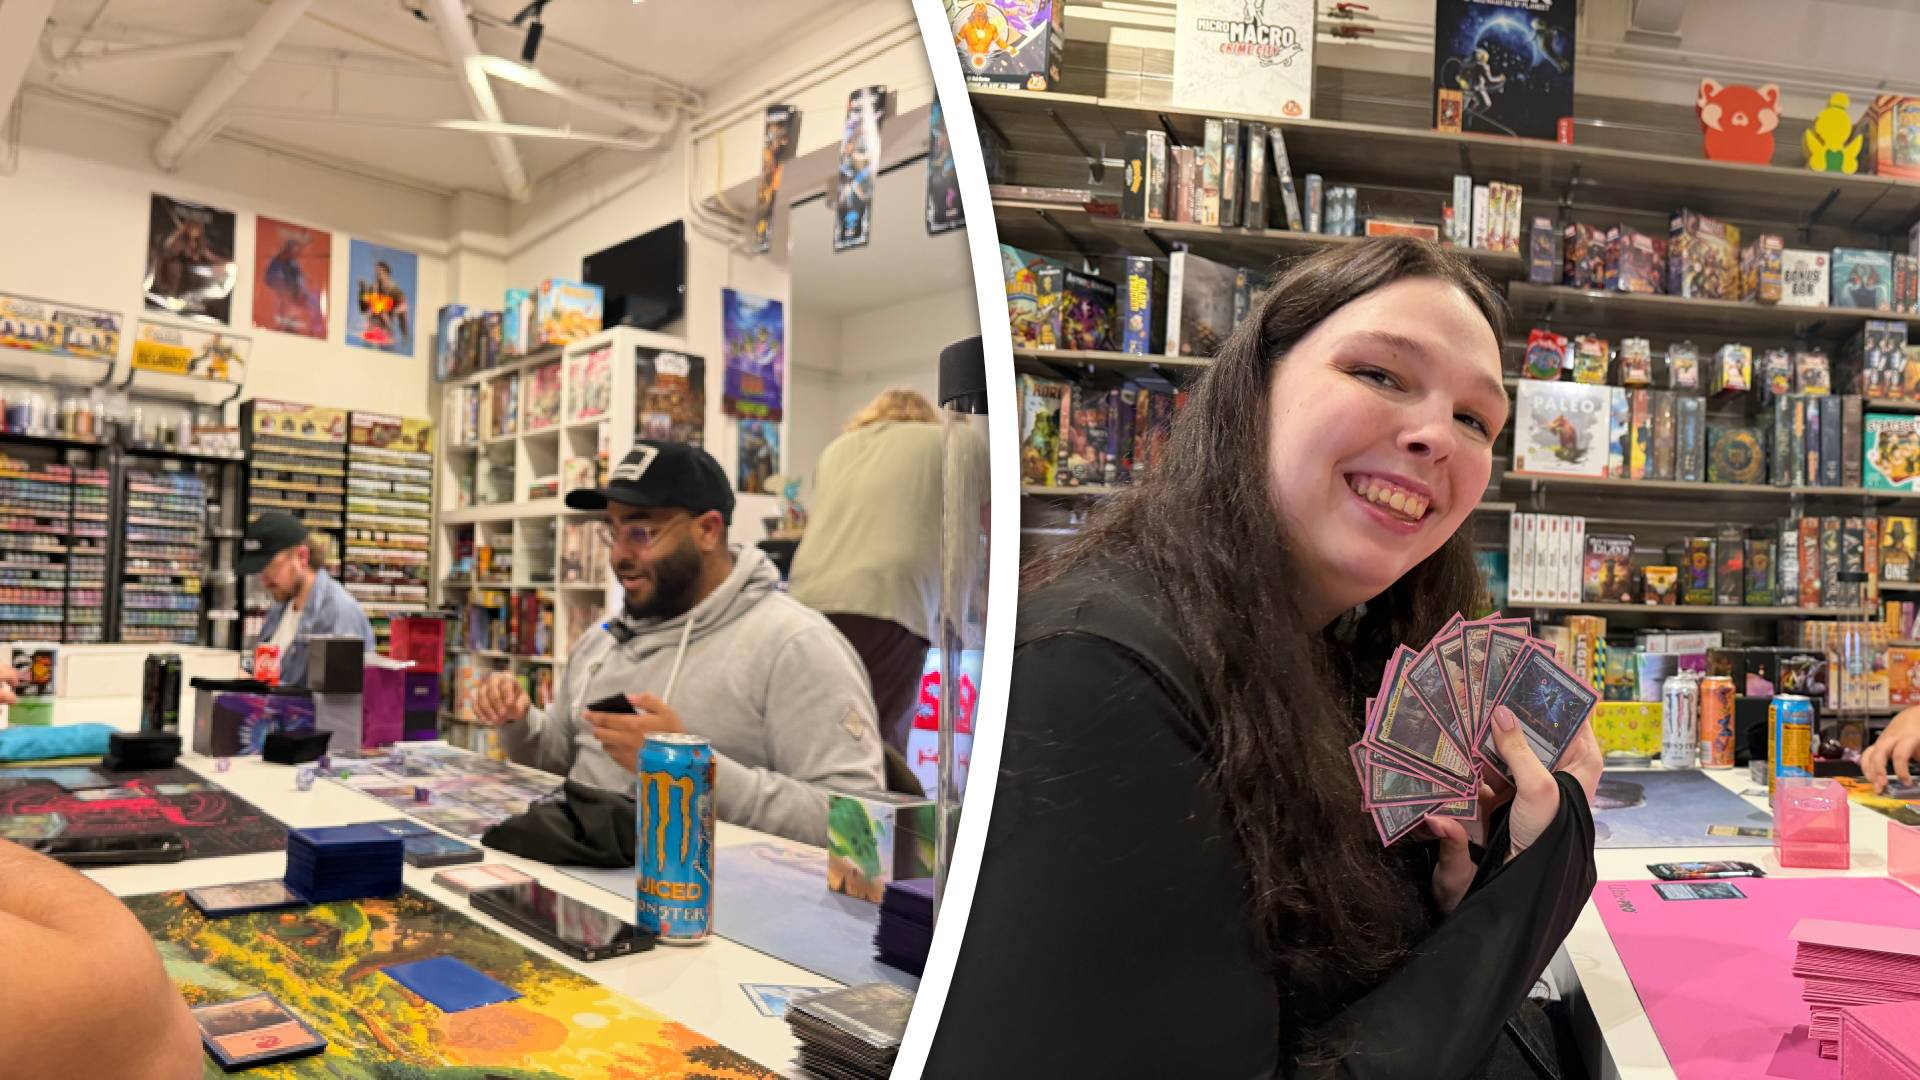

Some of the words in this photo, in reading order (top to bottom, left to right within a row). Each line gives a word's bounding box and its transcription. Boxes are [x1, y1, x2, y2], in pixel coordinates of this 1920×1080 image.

[1197, 18, 1229, 33] MICRO
[1229, 21, 1296, 48] MACRO
[1219, 43, 1253, 55] CRIME
[1533, 395, 1595, 414] PALEO
[1884, 563, 1910, 581] ONE
[1576, 634, 1588, 678] LEGAC
[637, 876, 702, 900] UICED
[639, 900, 705, 921] ONSTER
